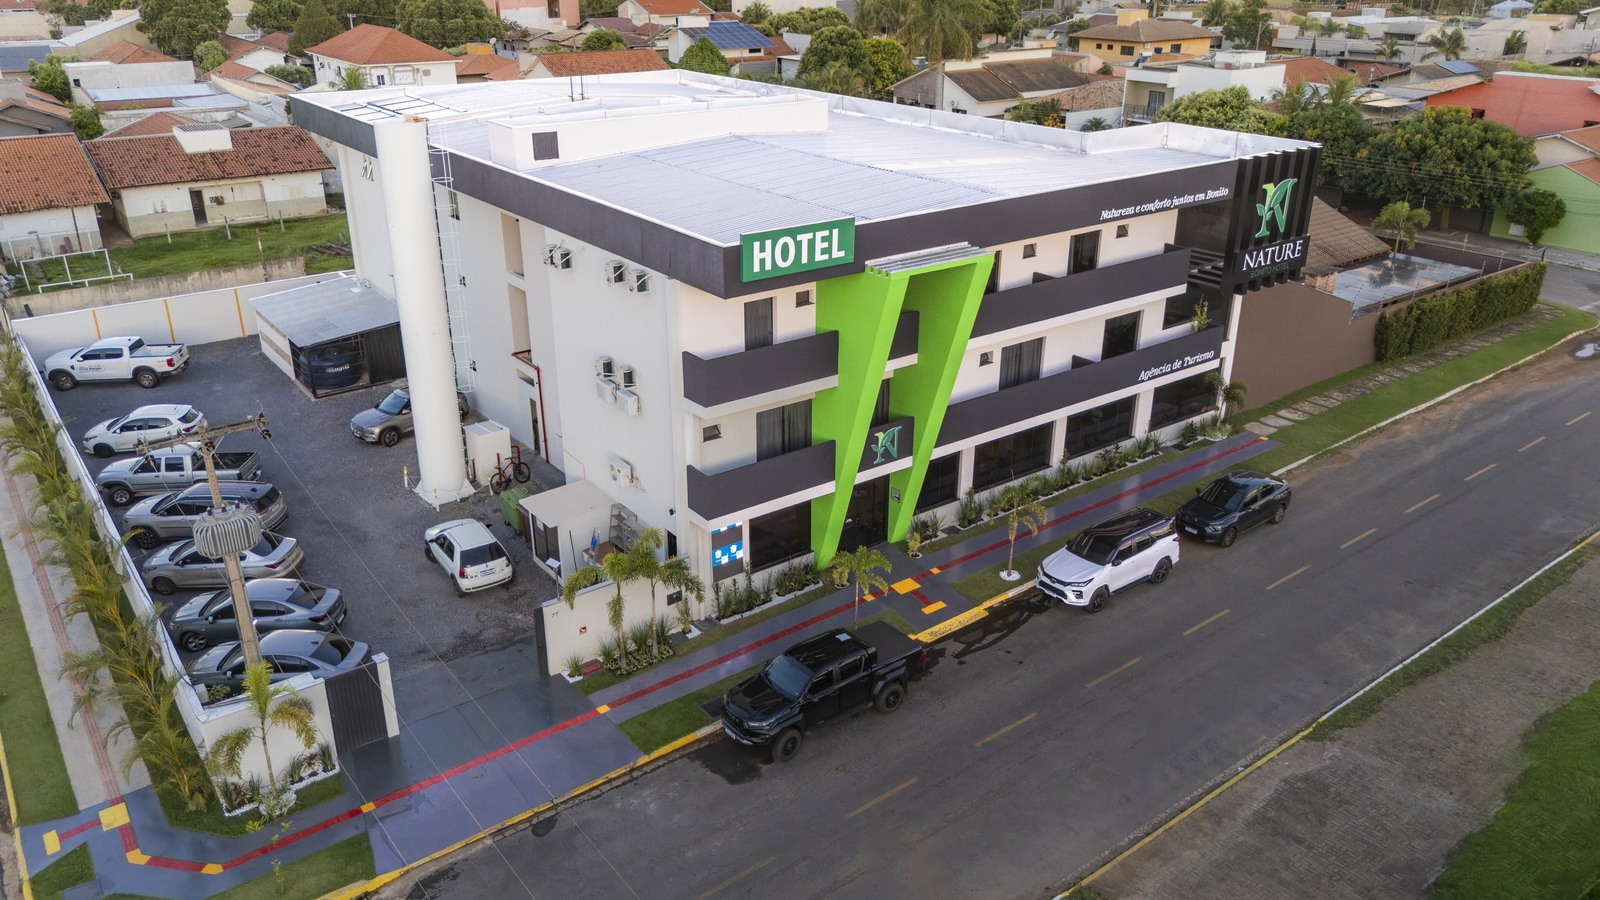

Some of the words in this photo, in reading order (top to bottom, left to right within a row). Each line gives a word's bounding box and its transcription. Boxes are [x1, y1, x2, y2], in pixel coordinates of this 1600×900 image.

[1099, 208, 1135, 221] Natureza
[1135, 205, 1141, 213] e
[1141, 198, 1171, 212] conforto
[1170, 194, 1194, 208] juntos
[1194, 193, 1206, 202] em
[1206, 187, 1229, 200] Bonito
[753, 228, 846, 273] HOTEL
[1242, 240, 1303, 271] NATURE
[1138, 363, 1171, 381] Agência
[1172, 359, 1183, 370] de
[1183, 350, 1215, 367] Turismo
